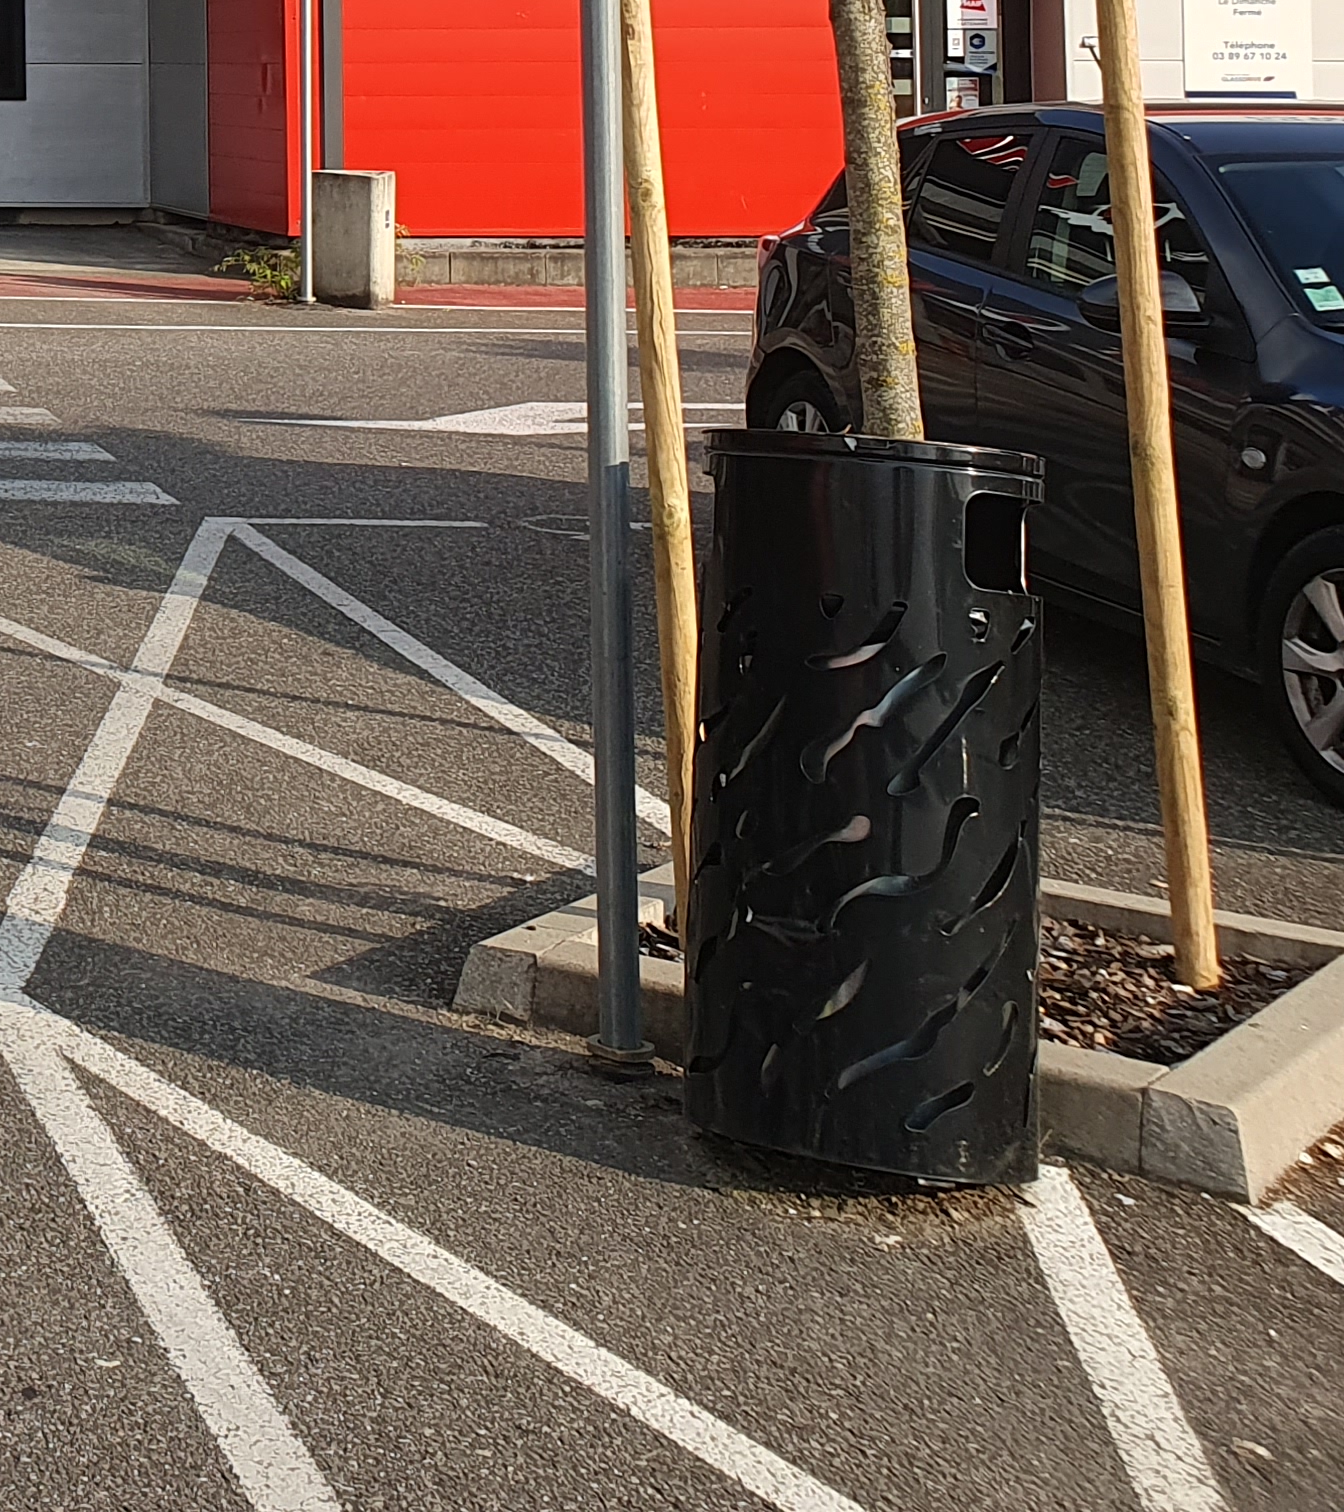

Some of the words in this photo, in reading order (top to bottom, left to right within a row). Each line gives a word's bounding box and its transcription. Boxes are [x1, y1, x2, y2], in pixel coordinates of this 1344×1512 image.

[1223, 40, 1276, 50] Téléphone
[1212, 52, 1225, 60] 03
[1228, 52, 1240, 60] 89
[1243, 52, 1256, 60] 67
[1259, 52, 1271, 60] 10
[1274, 52, 1287, 60] 24
